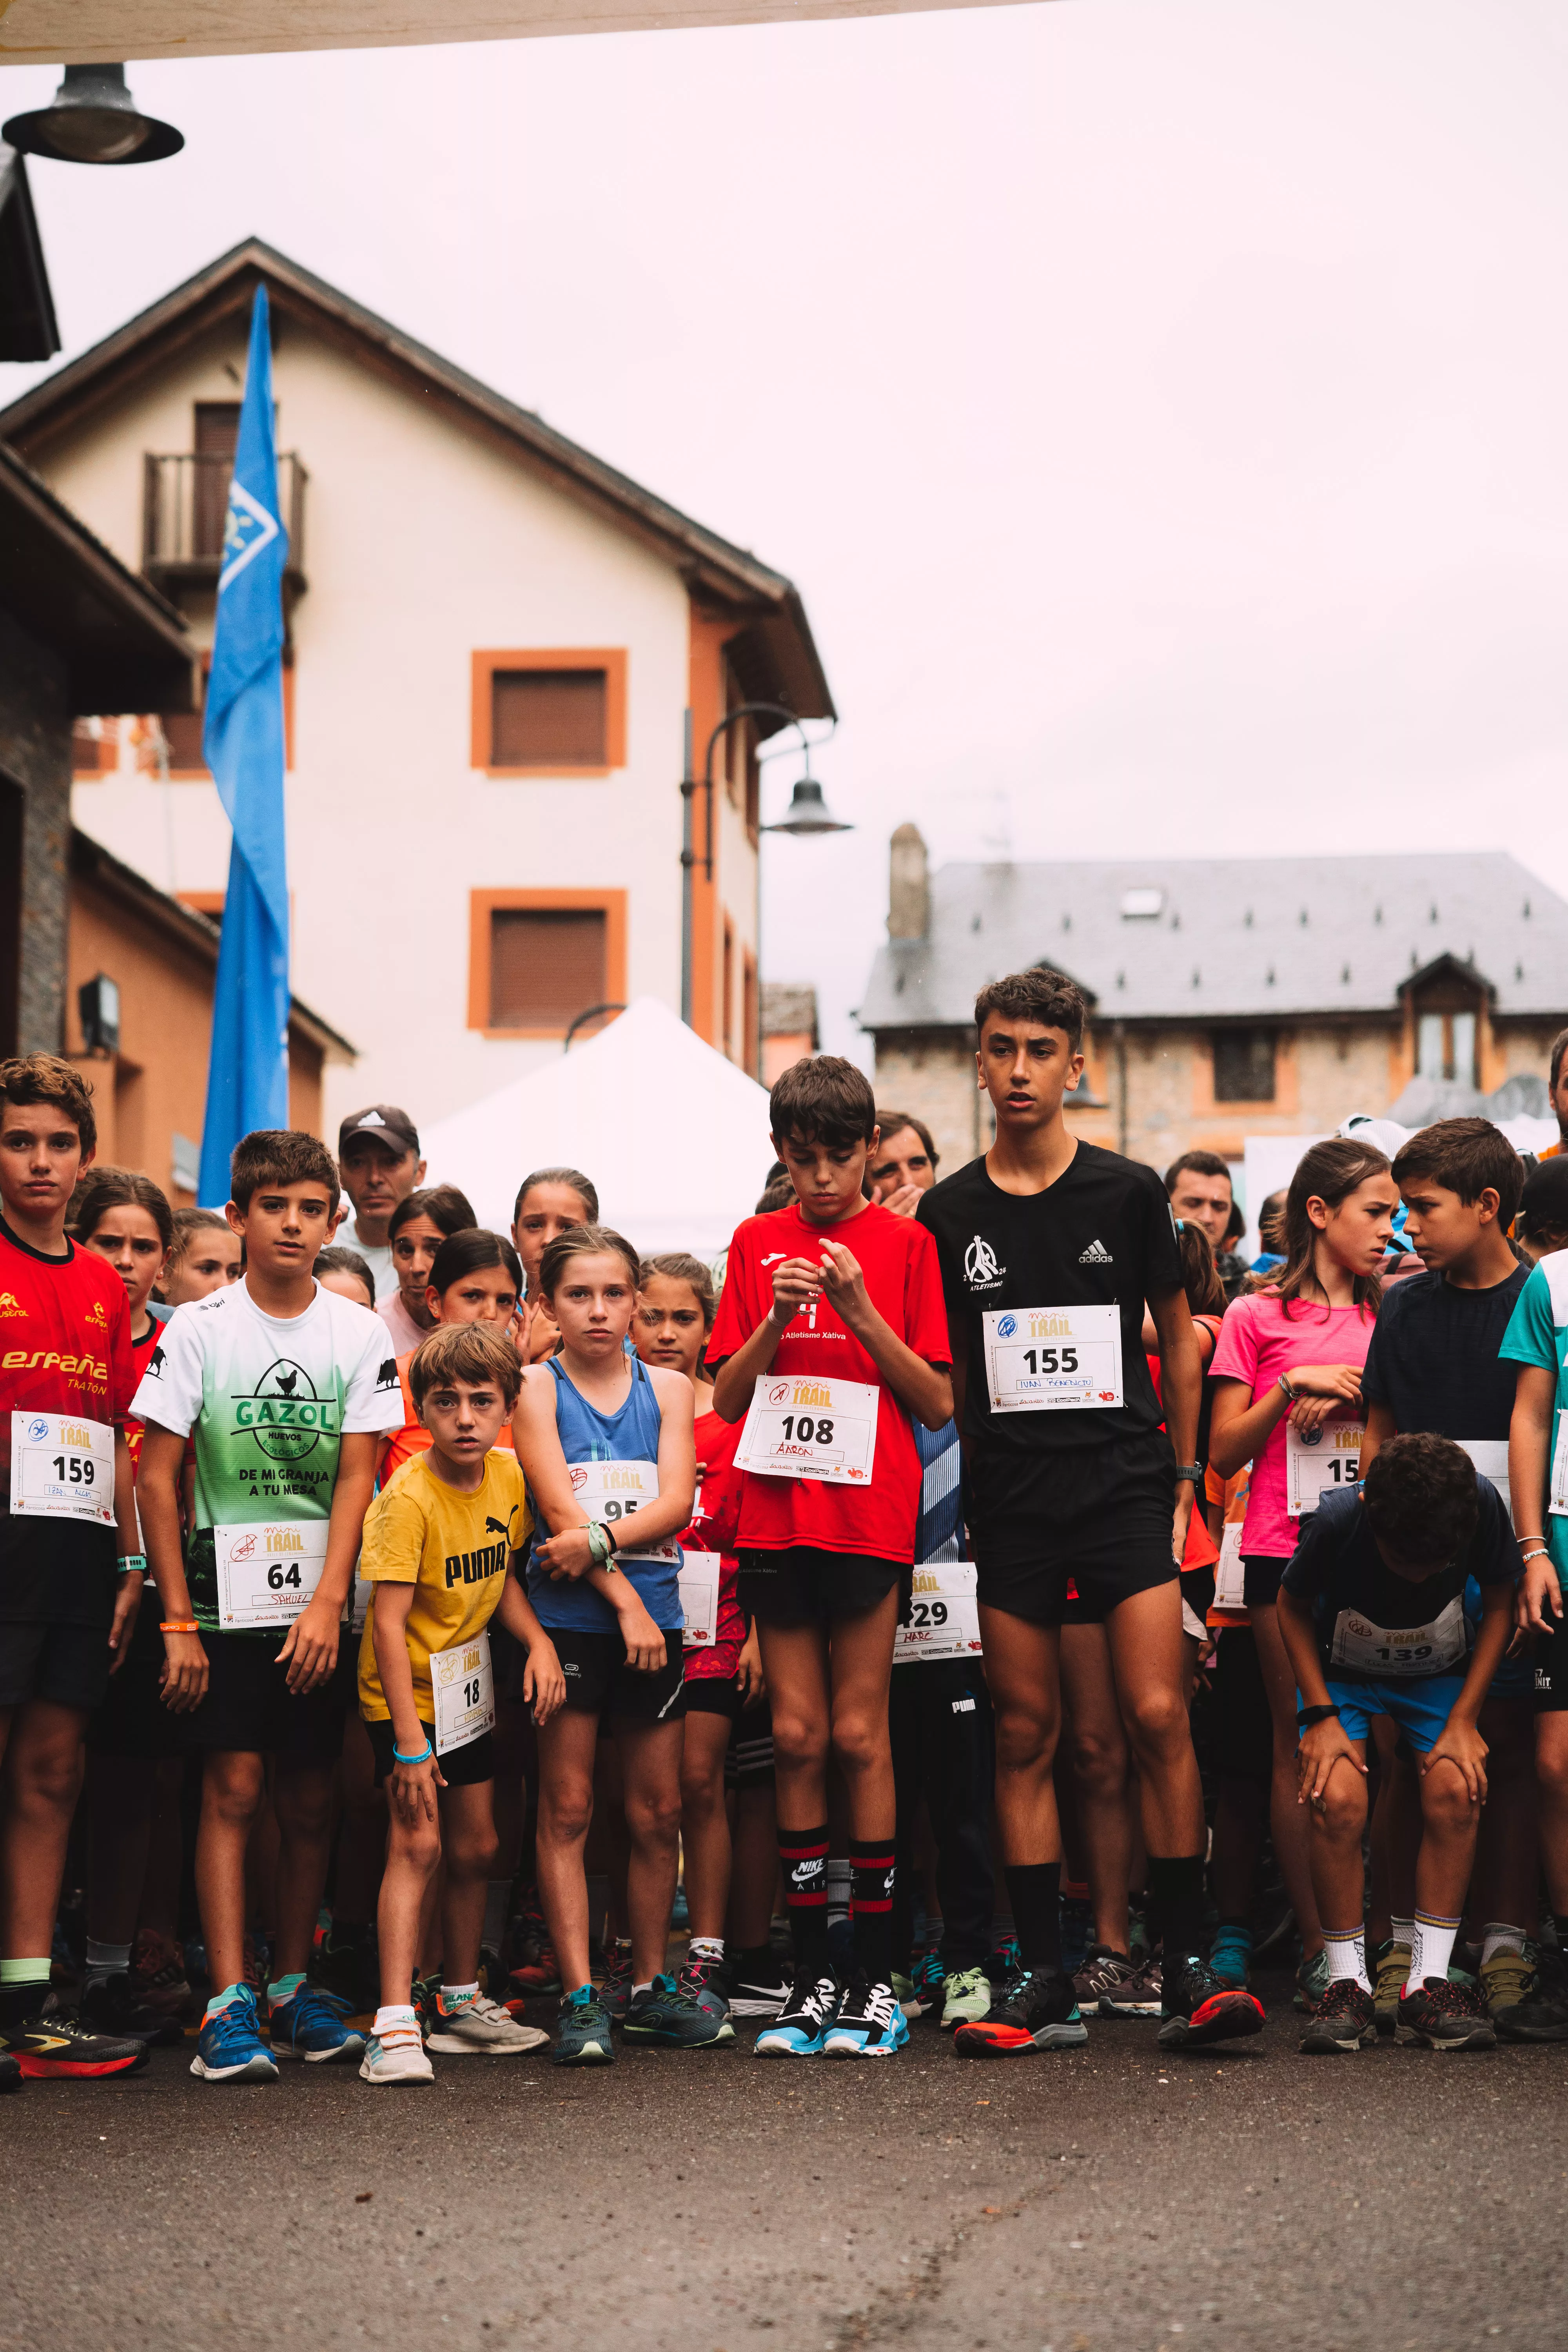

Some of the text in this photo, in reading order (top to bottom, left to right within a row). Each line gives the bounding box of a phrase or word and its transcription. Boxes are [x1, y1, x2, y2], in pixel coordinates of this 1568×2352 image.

[1079, 1254, 1113, 1263] adidas
[970, 1280, 1003, 1292] ATLETISMO
[1028, 1310, 1069, 1319] mini
[822, 1332, 846, 1340] Xàtiva
[1028, 1318, 1072, 1337] TRAIL
[2, 1351, 107, 1380] españa
[1023, 1348, 1078, 1374] 155
[794, 1379, 831, 1388] mini
[1020, 1378, 1091, 1388] IVAN BENEDICTO
[793, 1386, 832, 1407] TRAIL
[236, 1401, 334, 1430] GAZOL
[59, 1420, 89, 1430] mini
[782, 1416, 834, 1444] 108
[58, 1427, 91, 1448] TRAIL
[268, 1432, 302, 1441] HUEVOS
[262, 1439, 309, 1457] ECOLÓGICOS
[776, 1441, 813, 1456] AARON
[53, 1456, 94, 1485] 159
[240, 1468, 329, 1485] DE MI GRANJA
[1327, 1459, 1358, 1482] 15
[600, 1470, 642, 1489] TRAIL
[48, 1486, 91, 1498] IZAN ALGAS
[249, 1485, 317, 1496] A TU MESA
[604, 1501, 637, 1524] 95
[264, 1525, 301, 1534] mini
[263, 1533, 304, 1552] TRAIL
[445, 1541, 506, 1588] PUMA
[268, 1563, 301, 1590] 64
[913, 1575, 940, 1592] RAIL
[268, 1594, 311, 1606] SAMUEL
[903, 1602, 948, 1629] 29
[904, 1632, 934, 1643] MARC
[1383, 1632, 1428, 1644] TRAIL
[462, 1649, 481, 1673] TRAIL
[1375, 1645, 1432, 1661] 139
[464, 1679, 480, 1708] 18
[952, 1699, 975, 1713] PUMA
[797, 1858, 824, 1873] NIKE
[797, 1880, 825, 1891] AIR
